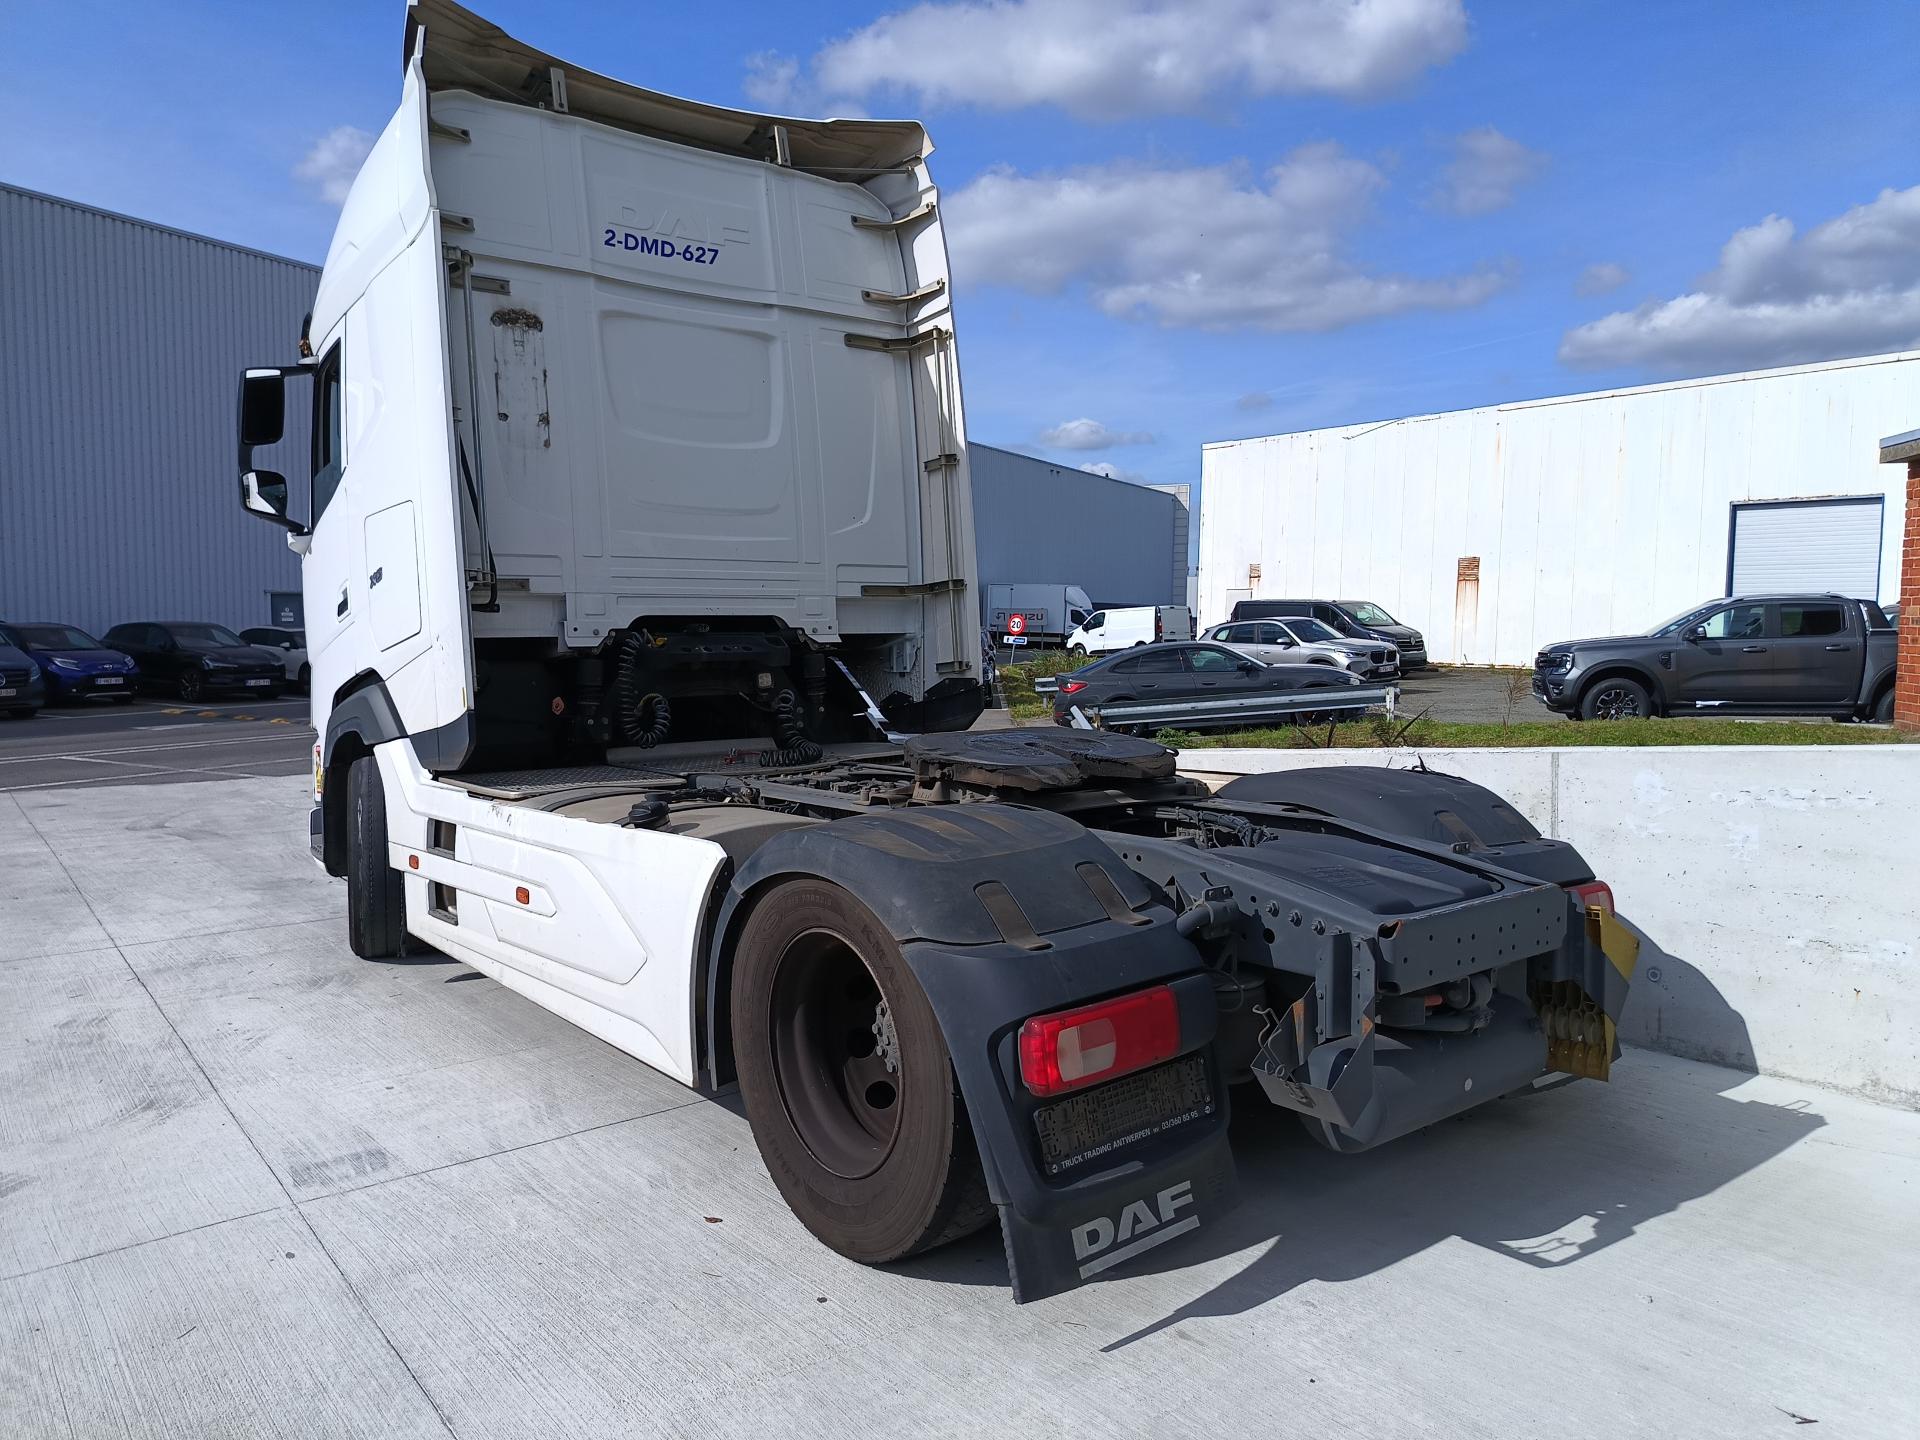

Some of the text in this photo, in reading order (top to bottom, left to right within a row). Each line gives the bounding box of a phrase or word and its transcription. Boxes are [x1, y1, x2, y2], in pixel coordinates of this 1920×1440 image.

[603, 228, 720, 265] 2-DMD-627
[1011, 620, 1021, 629] 20
[1060, 1154, 1083, 1169] TRUCK
[1083, 1143, 1112, 1161] TRADING
[1113, 1127, 1151, 1149] ANTWERPEN
[1071, 1180, 1194, 1261] DAF
